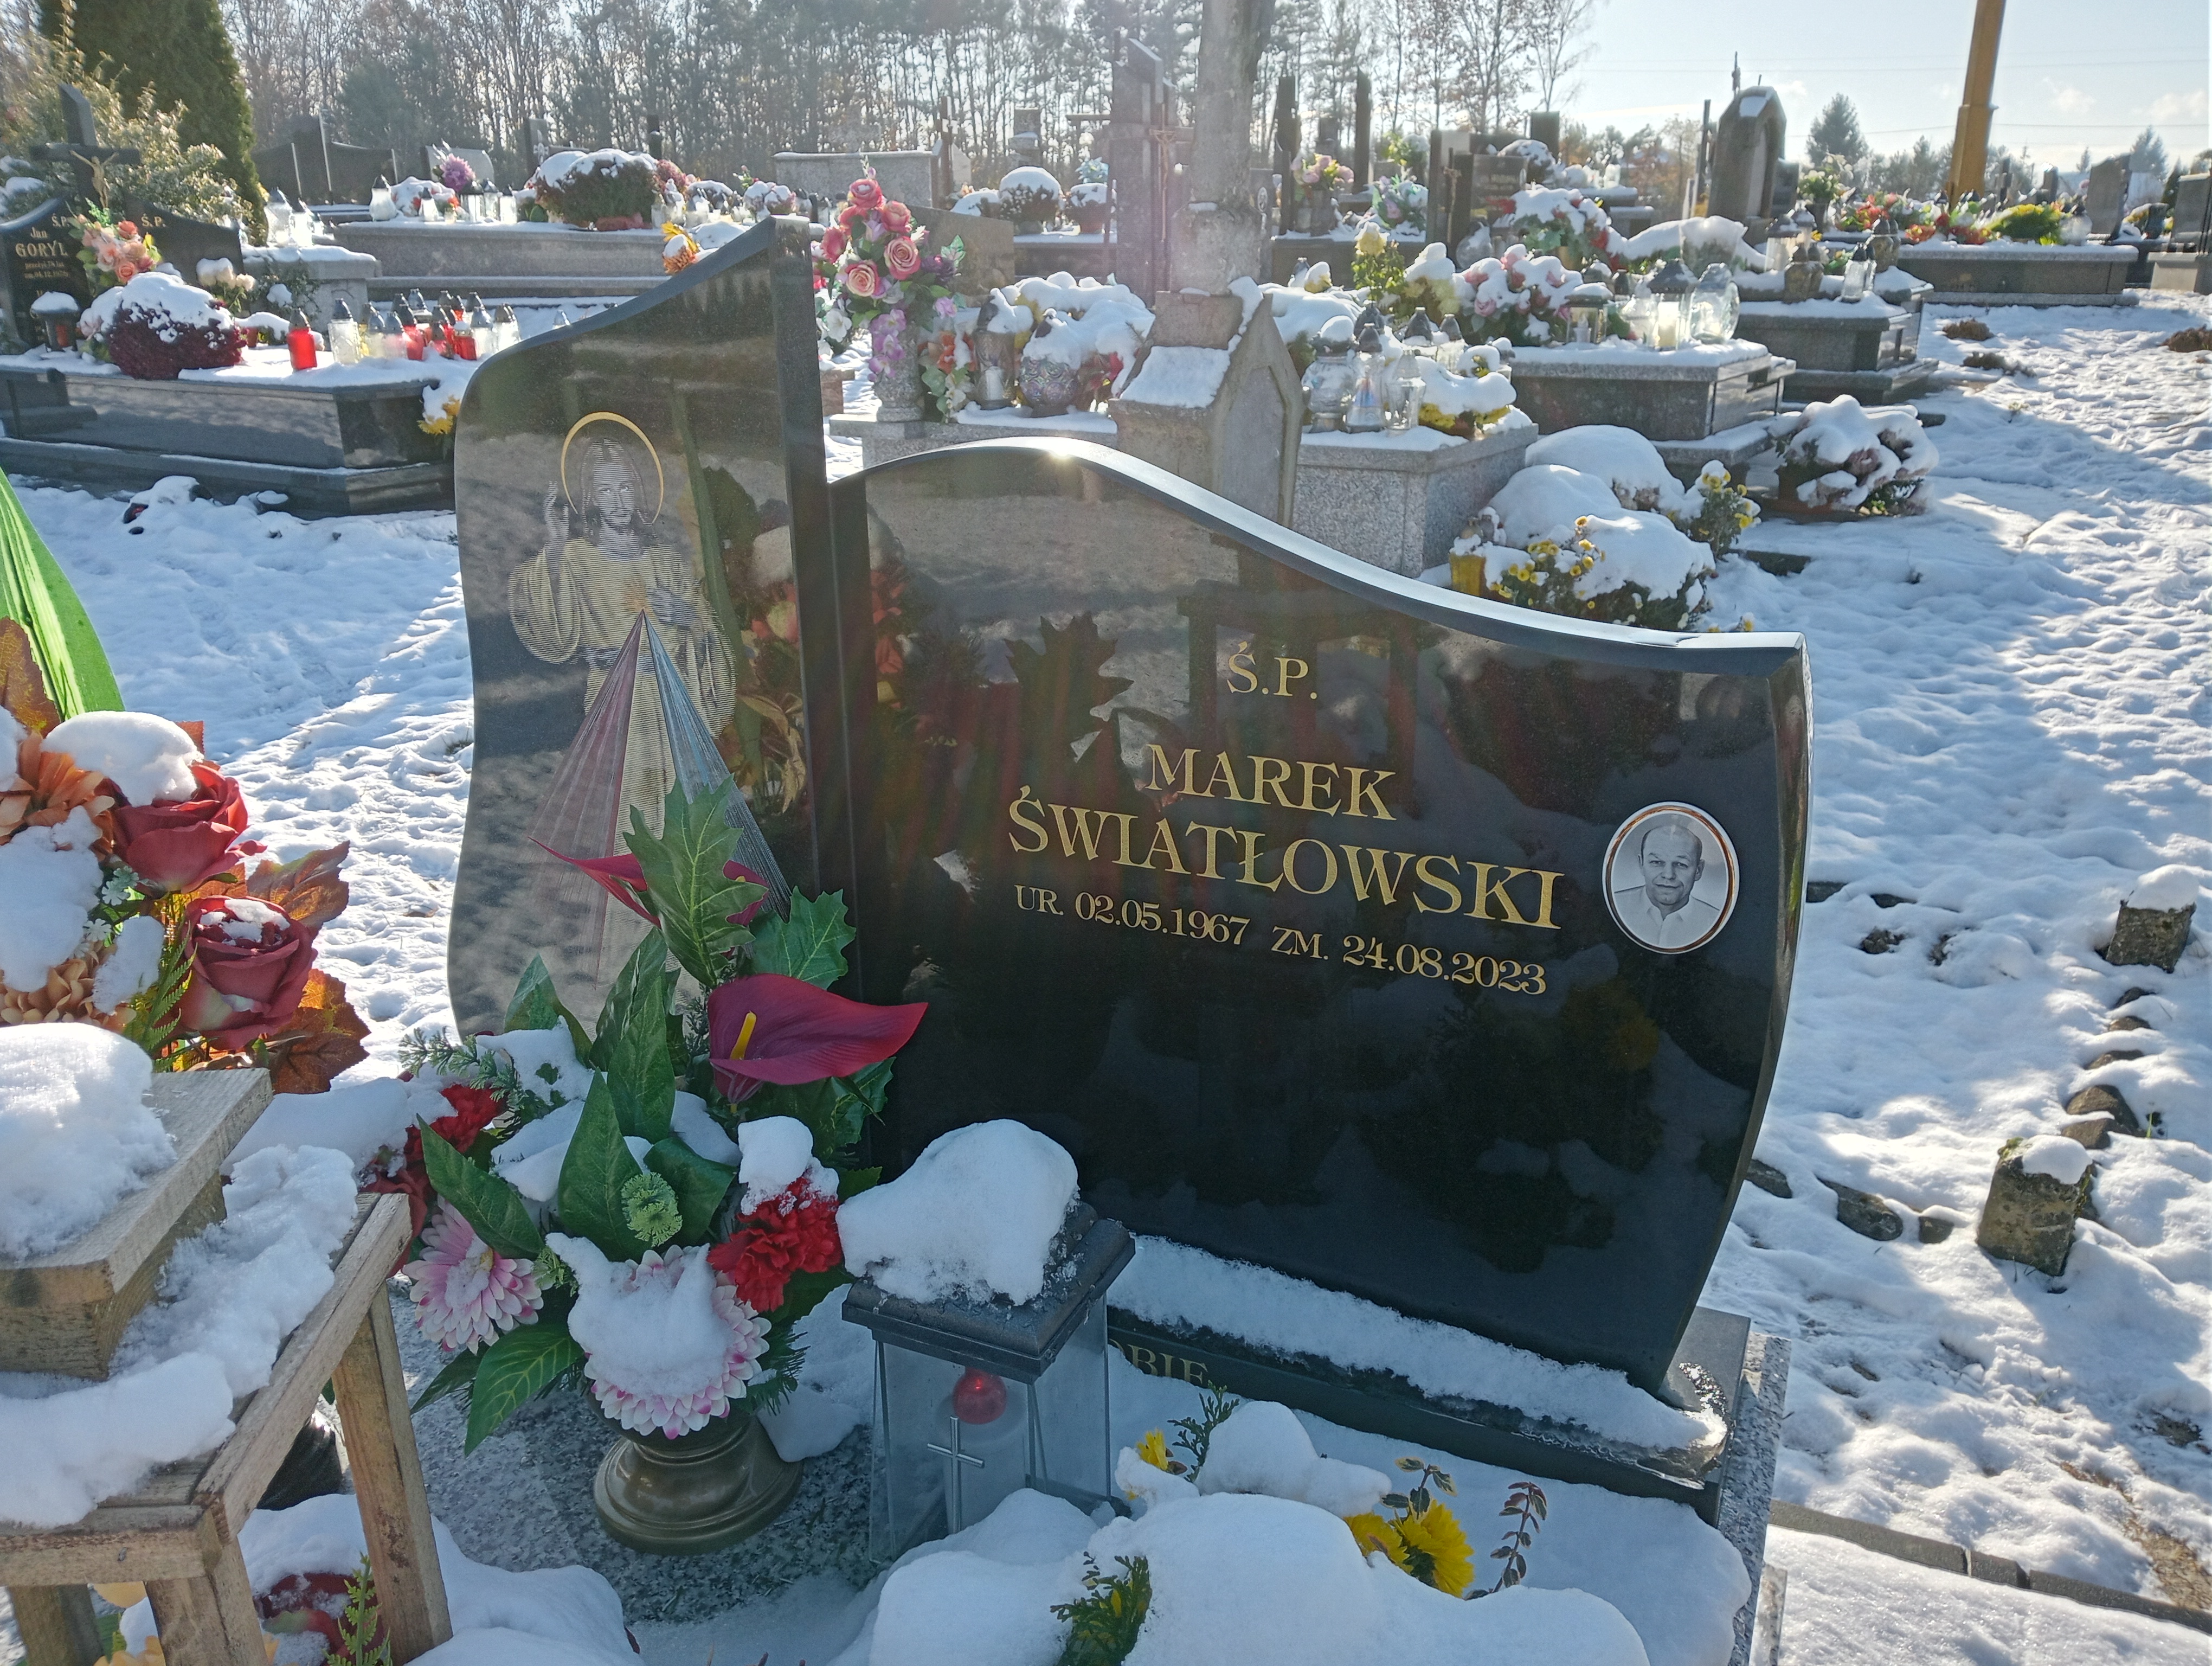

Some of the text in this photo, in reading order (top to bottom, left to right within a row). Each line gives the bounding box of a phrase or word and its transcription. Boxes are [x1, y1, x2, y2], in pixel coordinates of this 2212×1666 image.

[1227, 641, 1317, 700] Ś.P.
[1146, 744, 1397, 821] MAREK
[1008, 785, 1565, 930] ŚWIATŁOWSKI
[1014, 885, 1546, 995] UR. 02.05.1967 ZM. 24.08.2023
[1108, 1338, 1208, 1385] BIE
